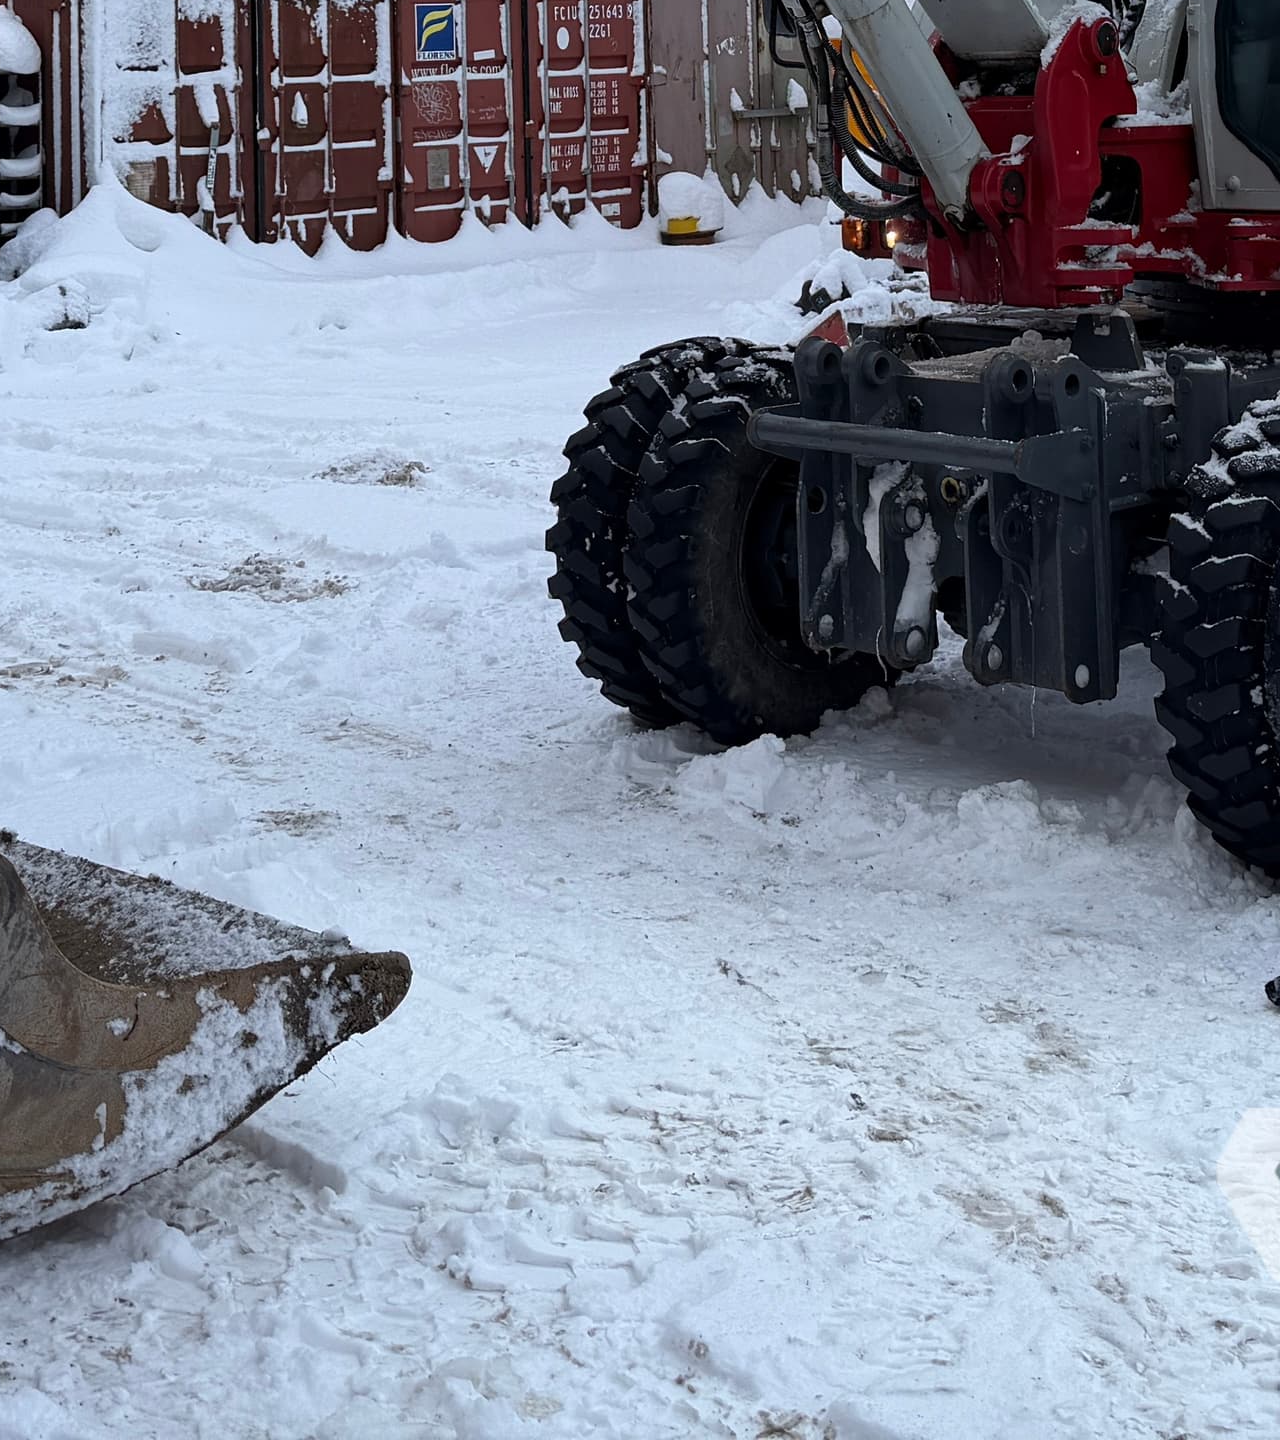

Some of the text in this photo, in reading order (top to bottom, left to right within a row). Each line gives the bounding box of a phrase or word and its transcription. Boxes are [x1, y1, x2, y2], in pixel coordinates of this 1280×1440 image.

[554, 6, 577, 20] FCIU
[589, 4, 623, 19] 251643
[589, 24, 610, 38] 22G1
[417, 51, 455, 60] FLORENS
[563, 86, 579, 98] GROSS
